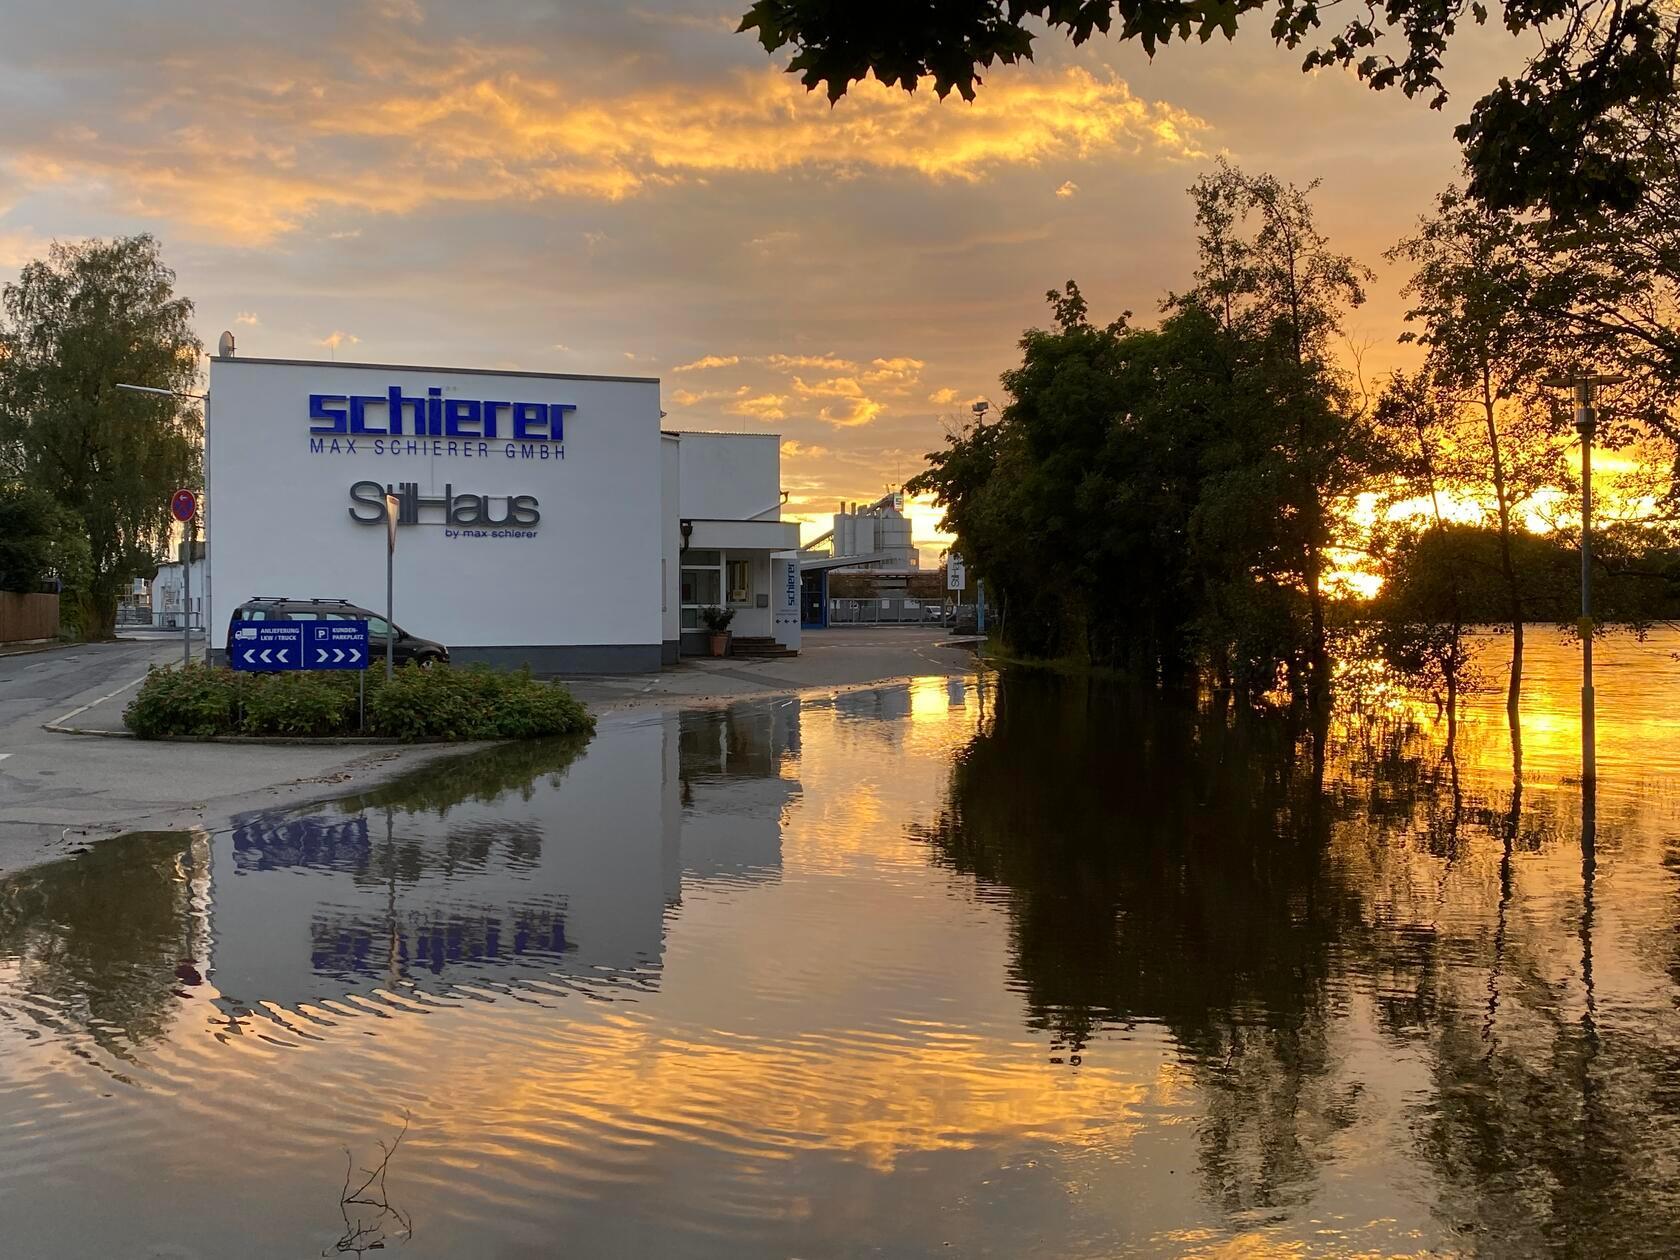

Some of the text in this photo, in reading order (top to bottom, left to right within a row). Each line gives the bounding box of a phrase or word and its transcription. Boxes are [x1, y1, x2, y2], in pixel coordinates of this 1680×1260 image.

[309, 386, 577, 441] schierer
[310, 438, 565, 460] MAX SCHIERER GMBH
[445, 528, 538, 539] by max schierer
[786, 561, 795, 607] schierer
